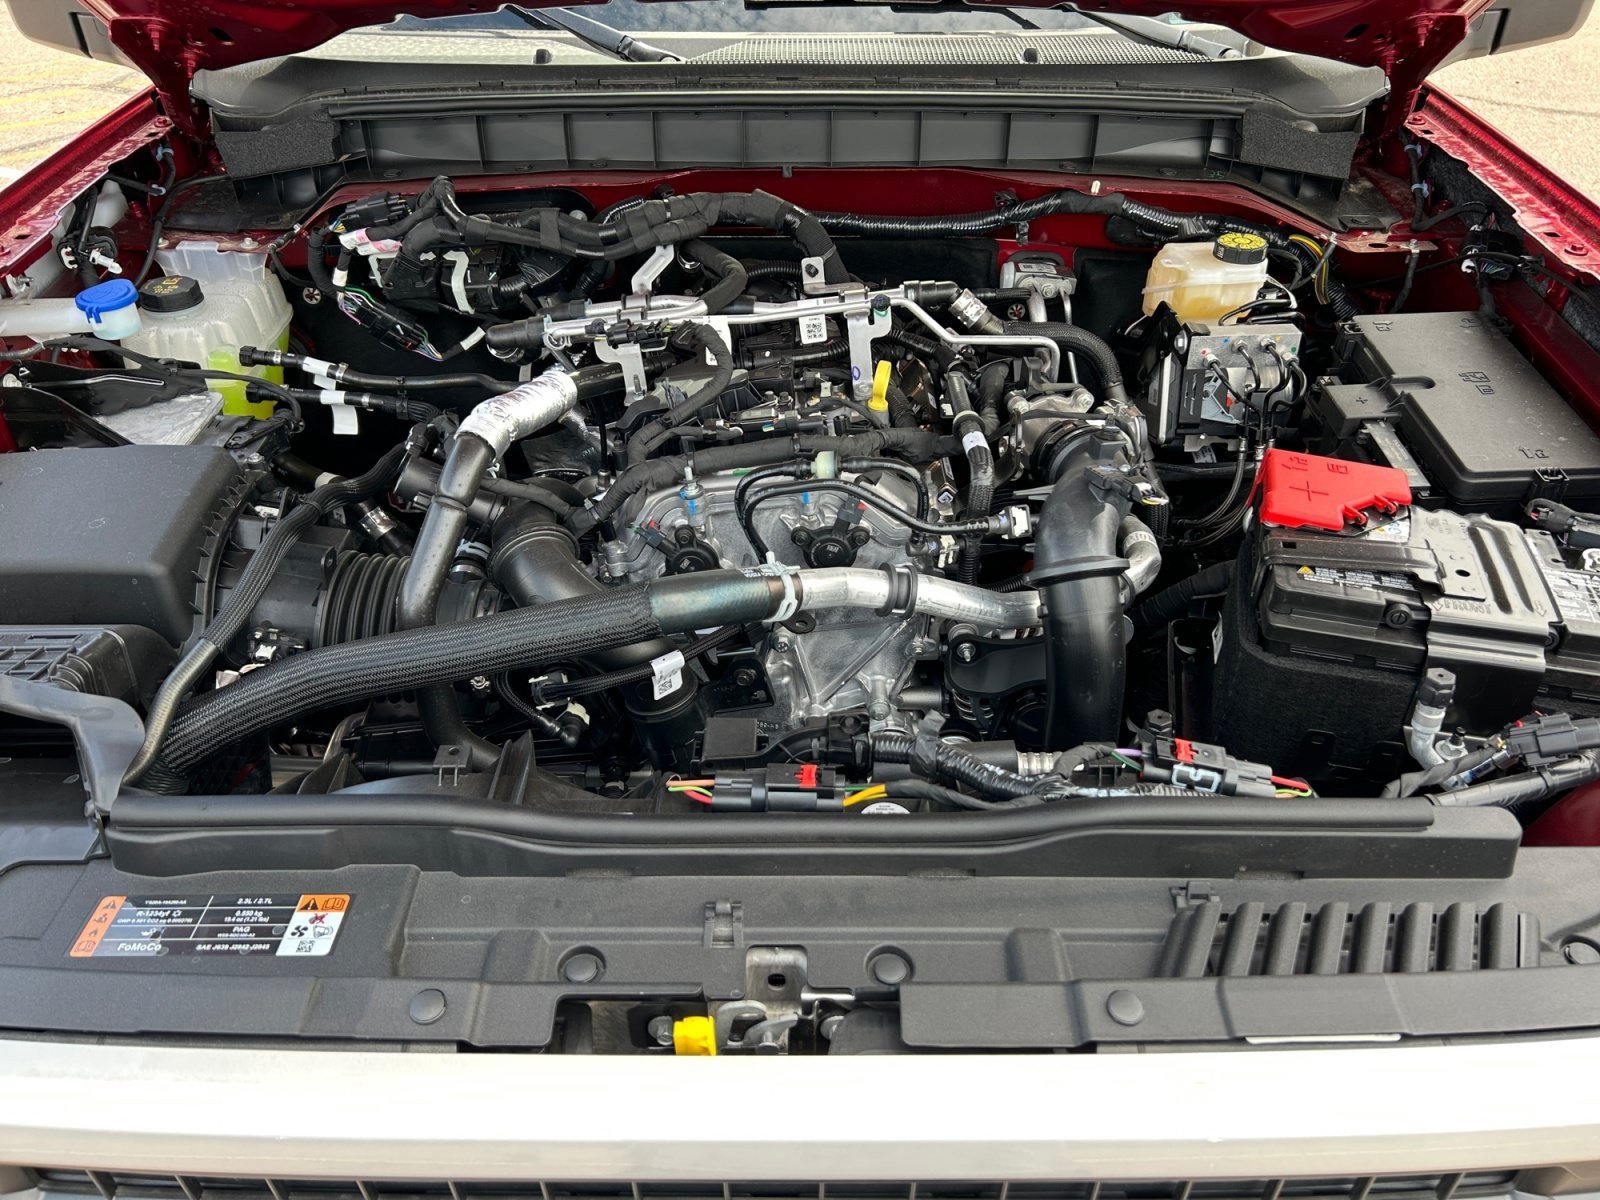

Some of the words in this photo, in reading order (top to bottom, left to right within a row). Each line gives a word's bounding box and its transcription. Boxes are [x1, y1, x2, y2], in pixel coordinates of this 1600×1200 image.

[136, 910, 171, 918] R-1234yf
[254, 910, 263, 918] kg
[117, 943, 162, 951] FoMoCo
